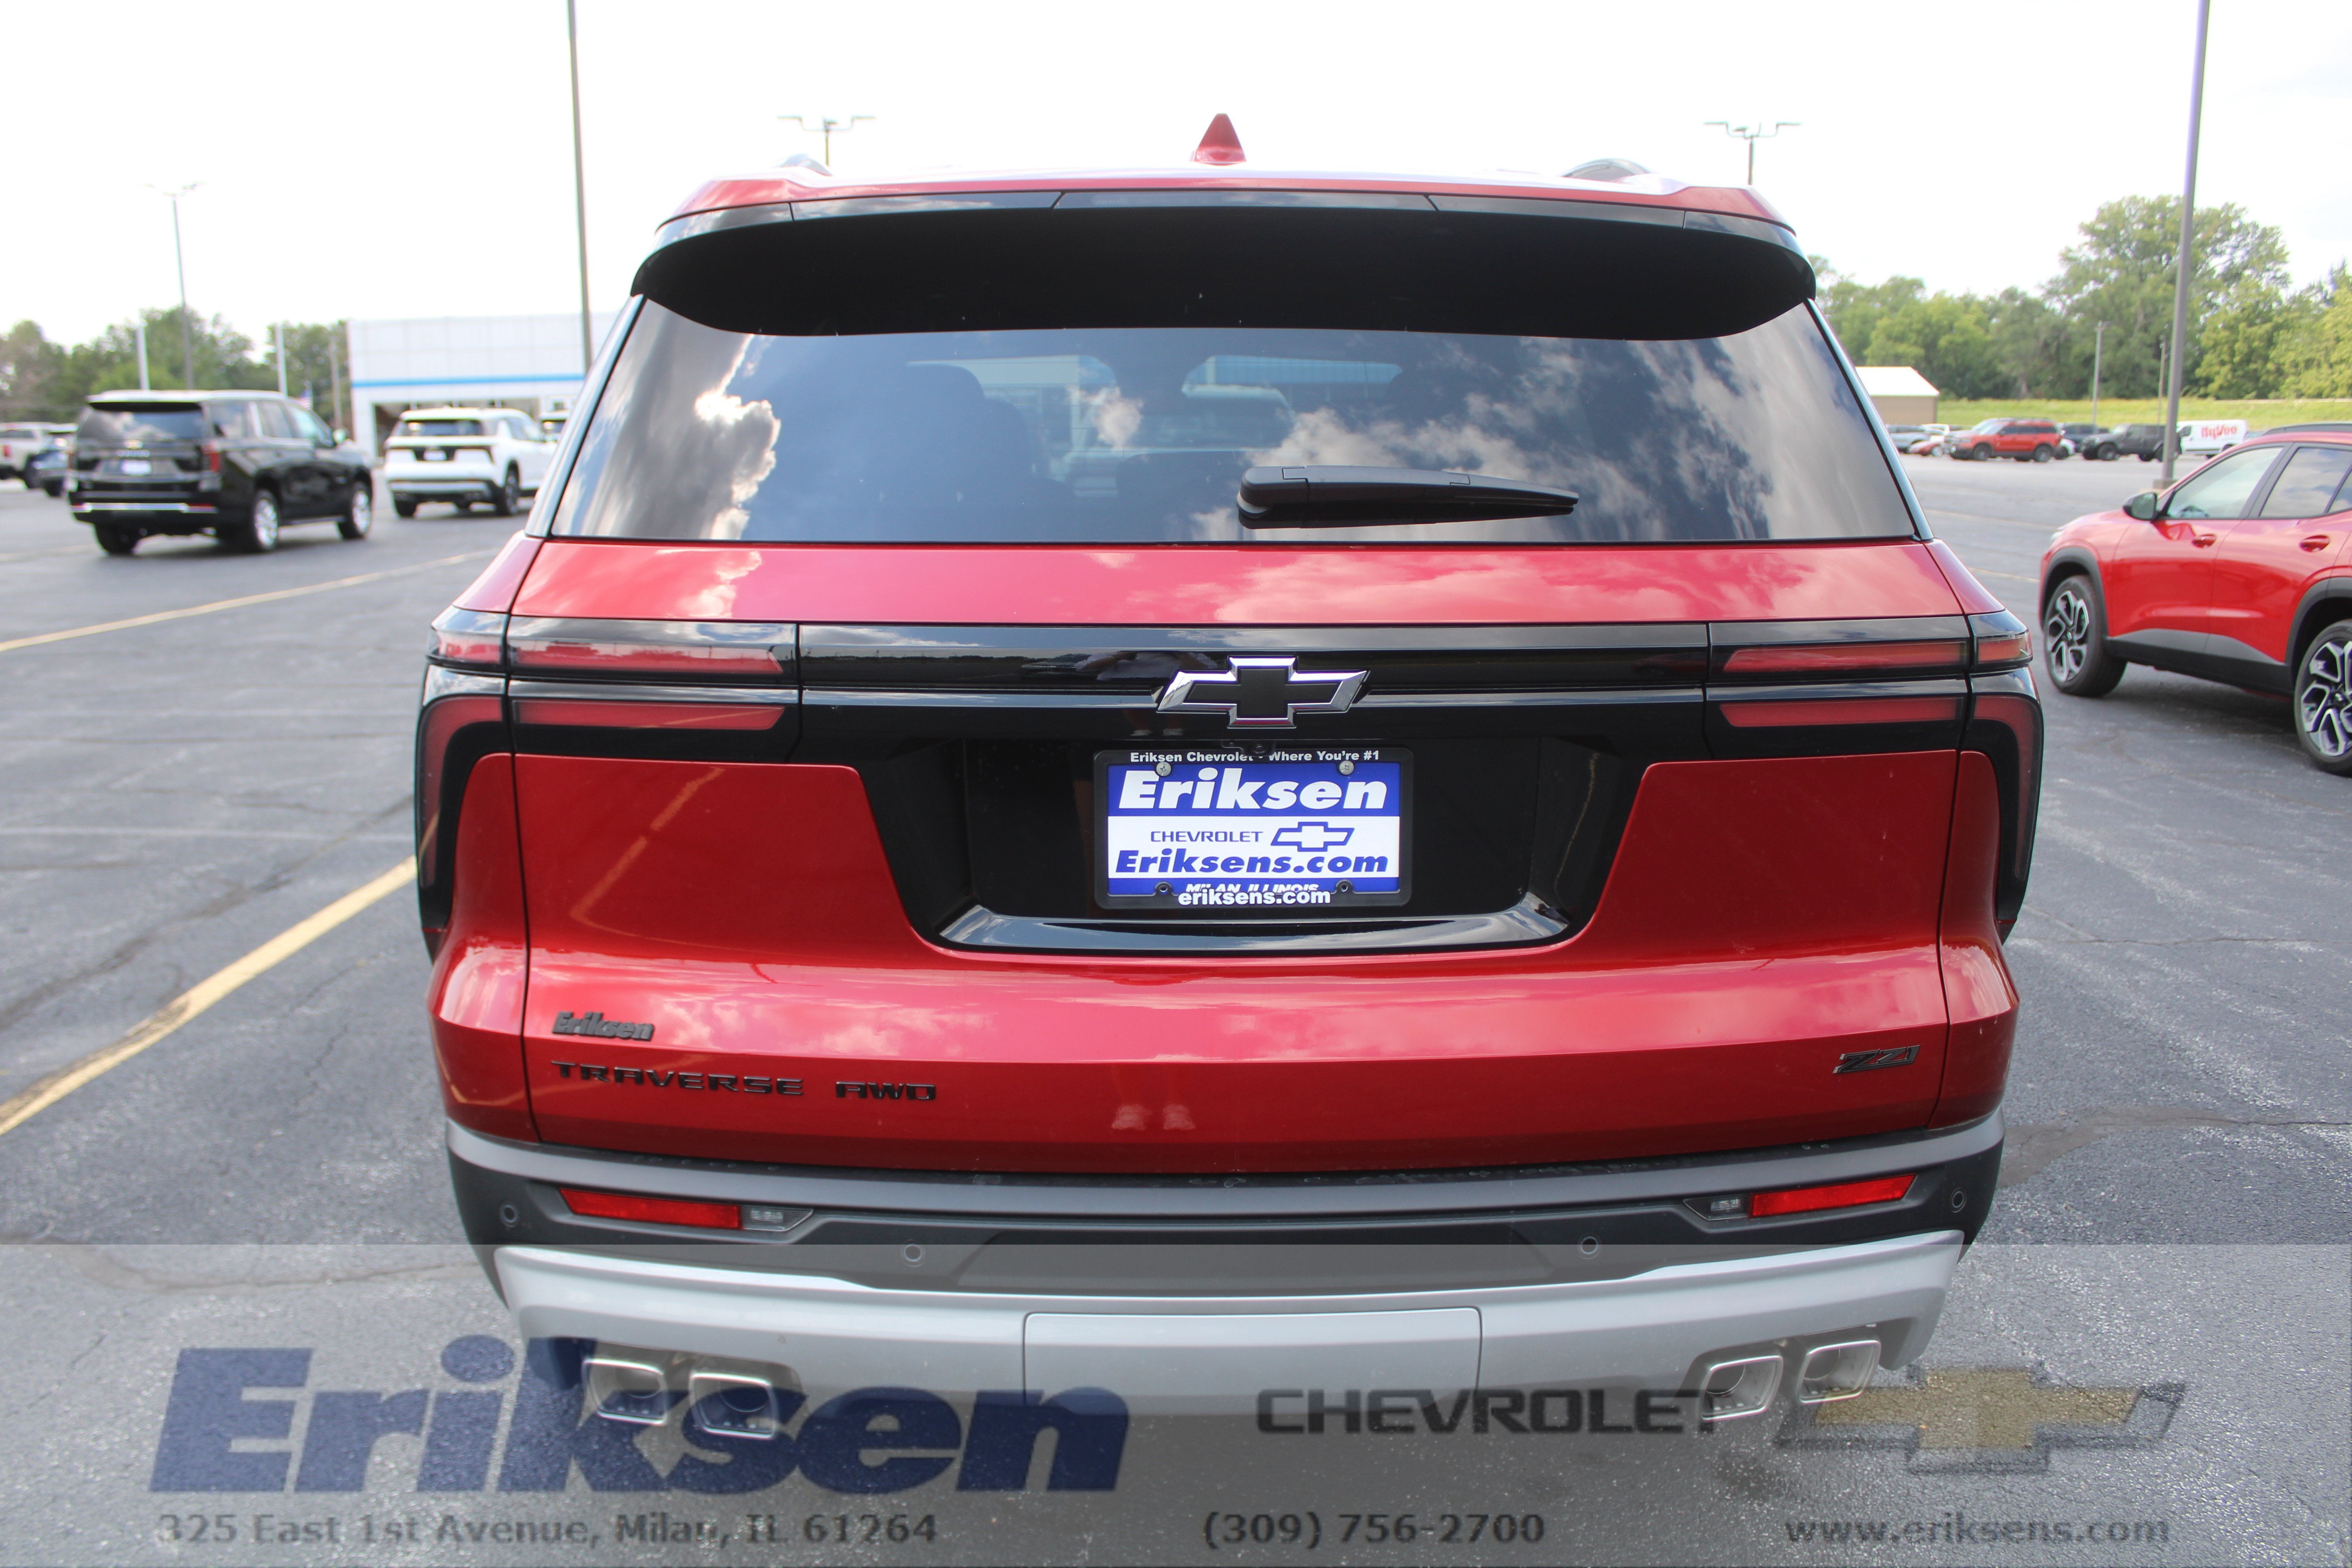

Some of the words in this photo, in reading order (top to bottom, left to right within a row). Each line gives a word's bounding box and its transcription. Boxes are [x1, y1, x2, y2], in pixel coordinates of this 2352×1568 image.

[1130, 752, 1182, 762] Eriksen
[1187, 752, 1253, 762] Chevrolet
[1269, 751, 1312, 761] Where
[1317, 751, 1359, 760] You're
[1364, 750, 1379, 760] #1
[1118, 768, 1388, 809] Eriksen
[1151, 831, 1263, 842] CHEVROLET
[1116, 849, 1388, 873] Eriksens.com
[1178, 888, 1331, 905] eriksens.com
[552, 1011, 655, 1041] Eriksen
[552, 1060, 804, 1095] TRAVERSE
[835, 1081, 936, 1100] AWD
